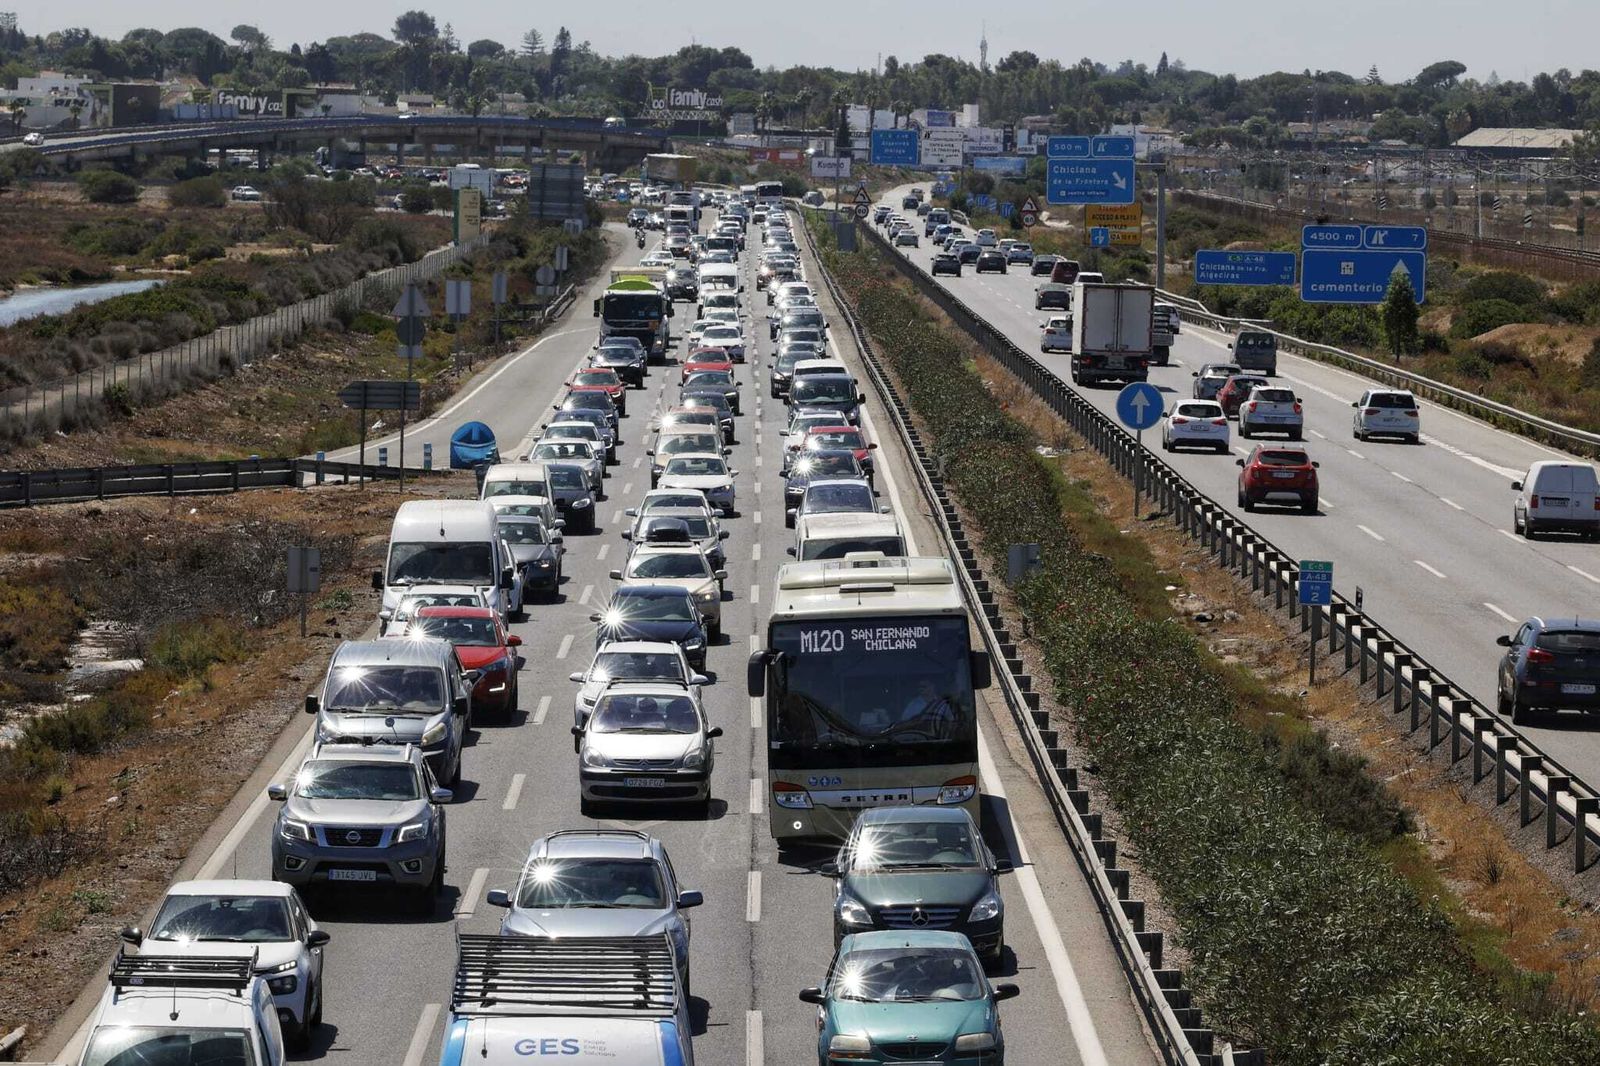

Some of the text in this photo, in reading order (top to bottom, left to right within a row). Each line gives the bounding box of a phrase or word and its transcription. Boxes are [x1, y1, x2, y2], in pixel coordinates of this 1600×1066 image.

[670, 88, 723, 110] family cash
[267, 102, 283, 112] cas
[1054, 143, 1072, 151] 500
[1053, 165, 1097, 174] Chiclana
[1310, 232, 1340, 240] 4500
[1199, 263, 1235, 271] Chiclana
[1199, 271, 1240, 280] Algeciras
[1311, 282, 1383, 293] cementerio
[1306, 573, 1327, 581] A-48
[1311, 592, 1319, 602] 2
[800, 627, 930, 653] M120 SAN FERNANDO
[865, 639, 917, 650] CHICLANA
[841, 794, 908, 803] SETRA
[515, 1039, 580, 1055] GES
